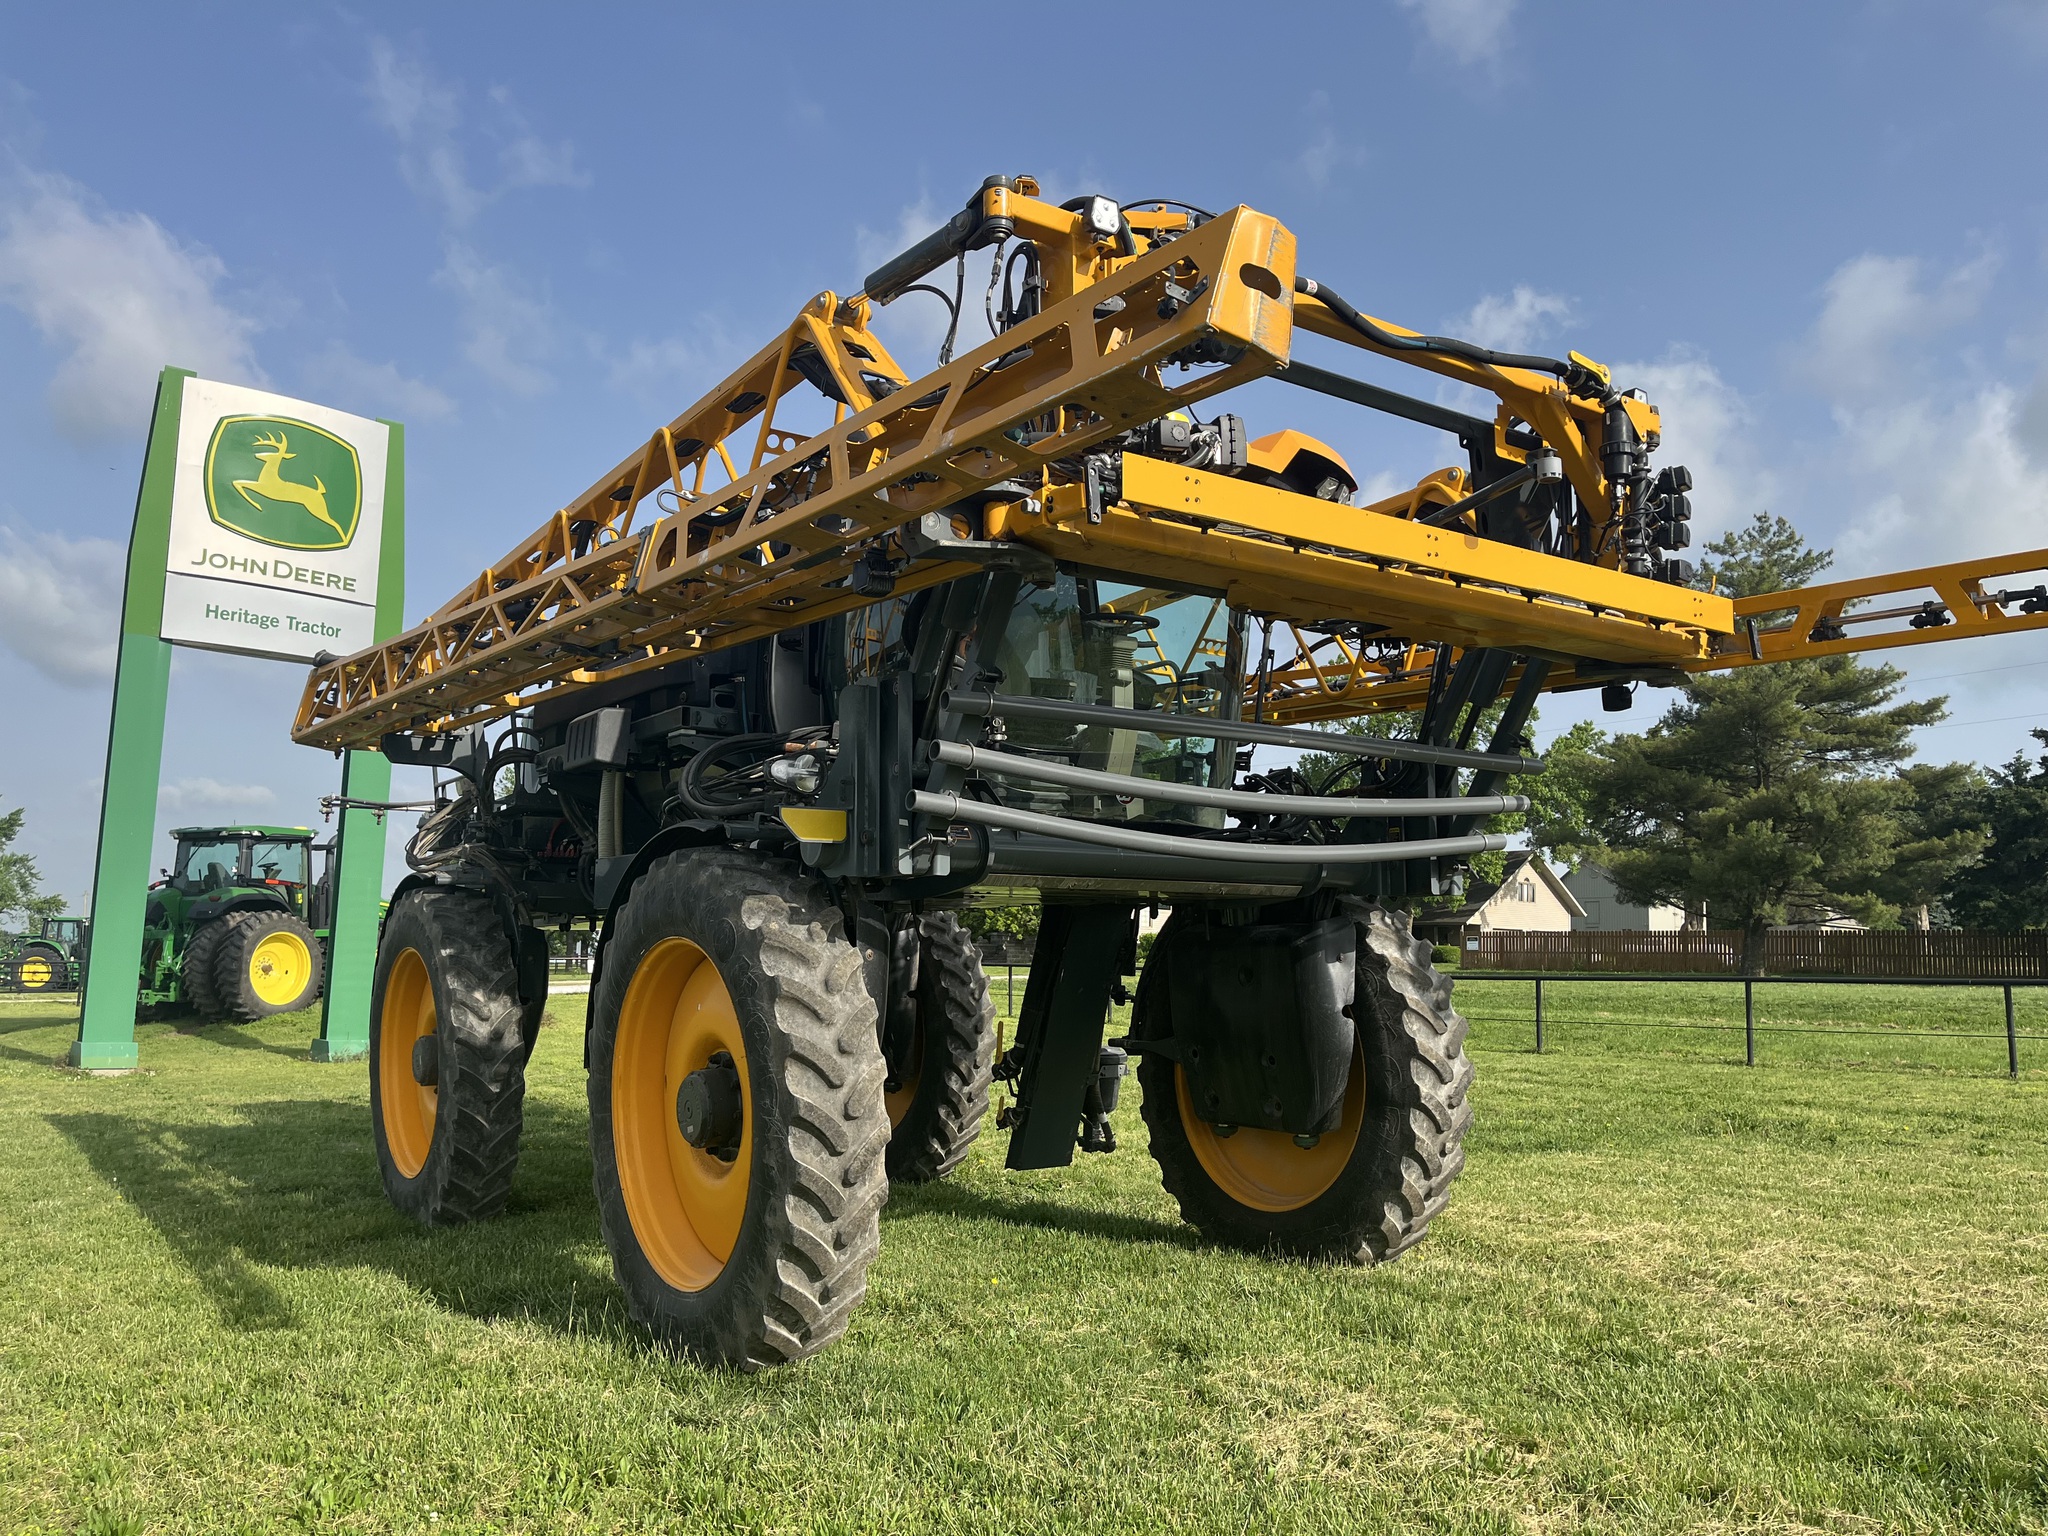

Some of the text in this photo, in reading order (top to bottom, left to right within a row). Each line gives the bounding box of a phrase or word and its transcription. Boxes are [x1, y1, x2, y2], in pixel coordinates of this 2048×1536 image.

[191, 548, 357, 593] JOHN DEERE
[205, 603, 342, 638] Heritage Tractor
